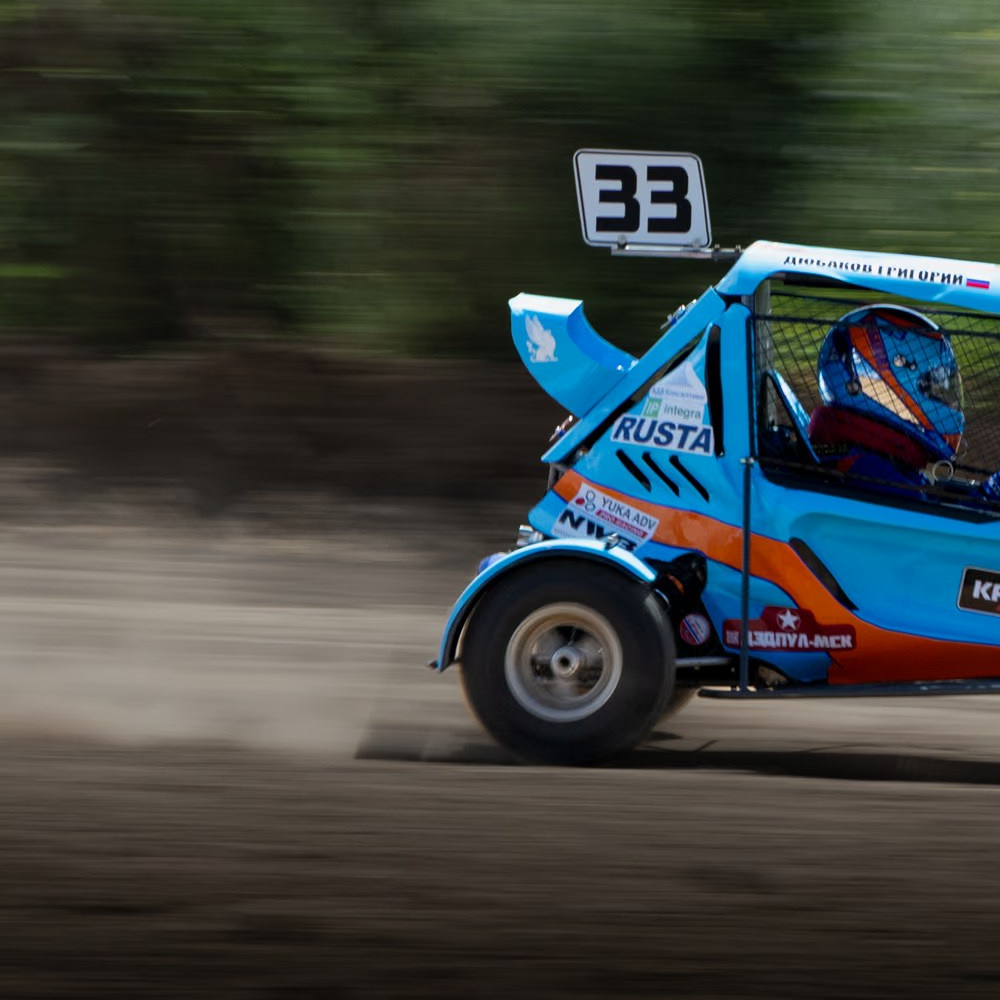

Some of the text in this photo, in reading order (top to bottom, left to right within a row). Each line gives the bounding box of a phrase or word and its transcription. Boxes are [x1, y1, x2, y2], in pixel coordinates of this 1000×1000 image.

[595, 164, 692, 234] 33
[663, 403, 701, 420] integra
[613, 416, 712, 454] RUSTA
[602, 496, 656, 530] YUKA ADV
